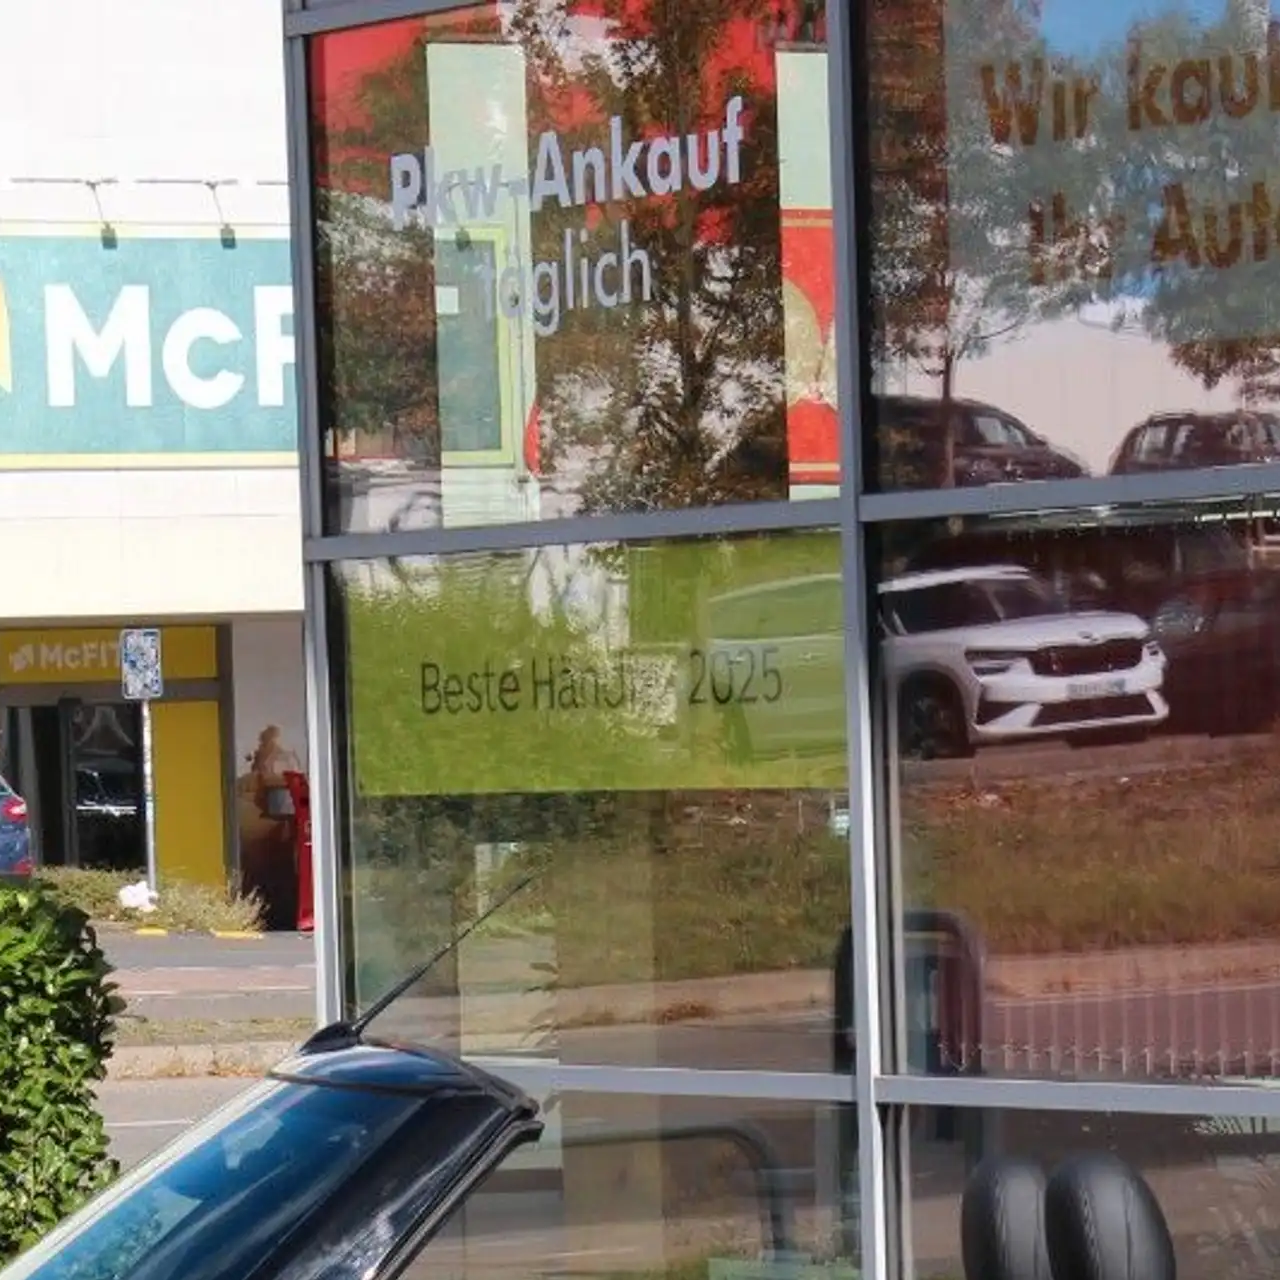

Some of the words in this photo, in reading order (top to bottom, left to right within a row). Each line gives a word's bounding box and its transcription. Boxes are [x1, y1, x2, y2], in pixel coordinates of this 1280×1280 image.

[980, 57, 1097, 145] Wir
[420, 661, 520, 714] Beste
[688, 648, 782, 704] 2025
